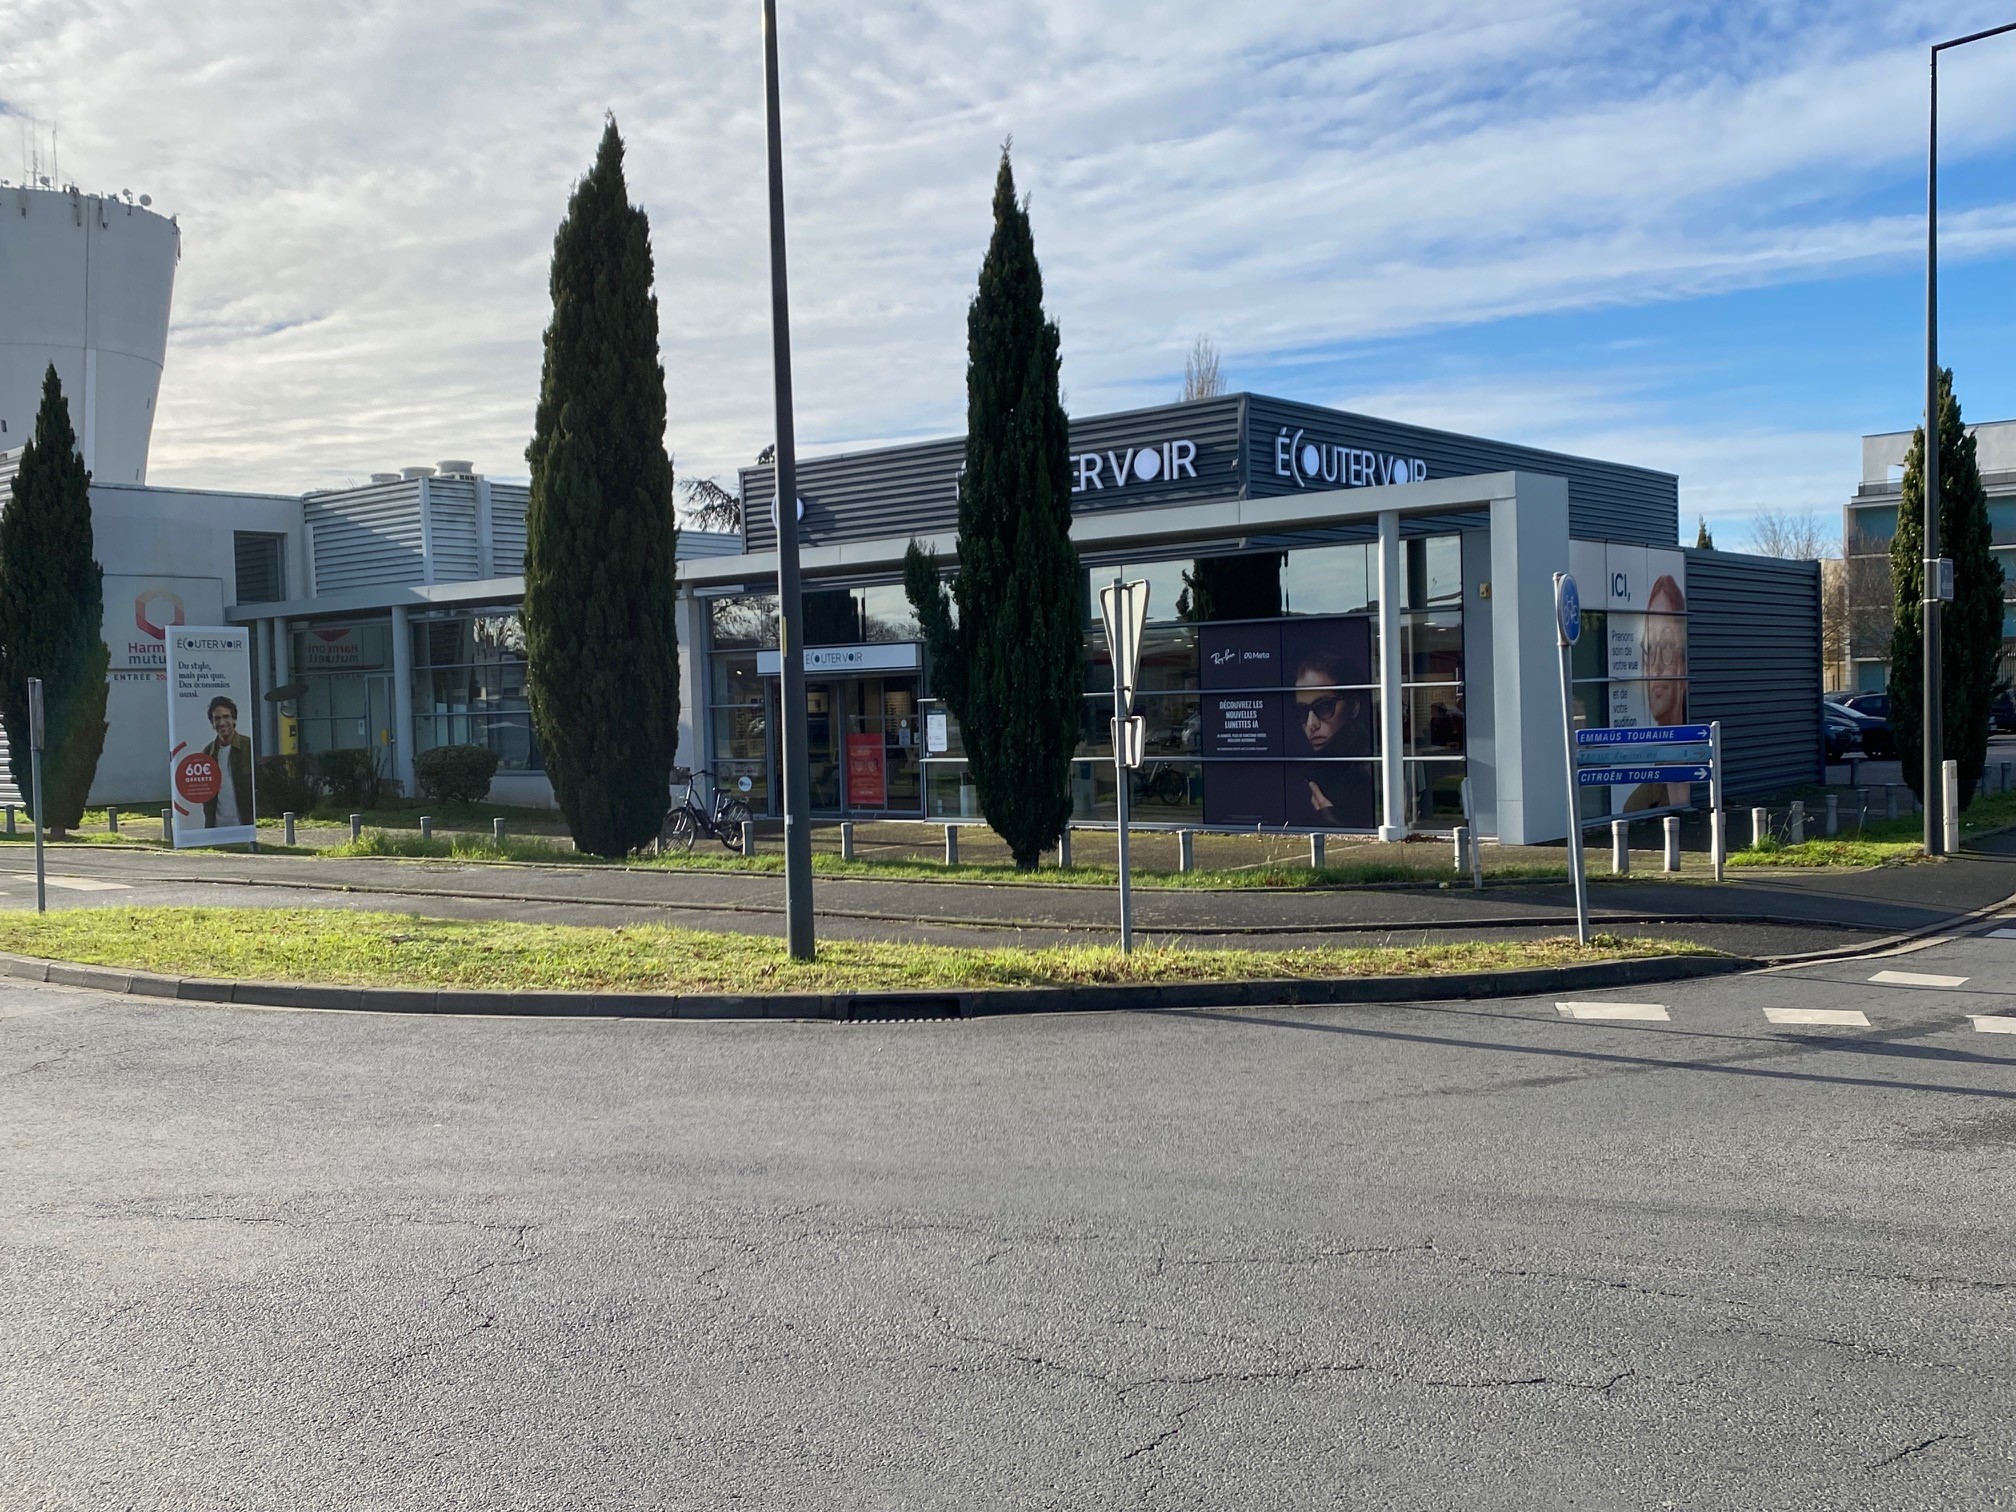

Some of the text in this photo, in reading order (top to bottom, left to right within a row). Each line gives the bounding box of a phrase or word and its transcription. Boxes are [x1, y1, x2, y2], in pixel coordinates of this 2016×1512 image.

[1107, 438, 1199, 487] VOIR
[1378, 453, 1427, 486] VOIR
[1611, 572, 1631, 602] ICI,
[128, 642, 165, 653] Harm
[220, 639, 243, 649] VOIR
[1624, 645, 1633, 656] de
[128, 654, 166, 664] mutu
[842, 651, 863, 663] VOIR
[178, 661, 190, 670] Du
[1628, 660, 1639, 671] vue
[113, 672, 151, 681] ENTRÉE
[1620, 688, 1629, 700] de
[1219, 699, 1264, 710] DÉCOUVREZ LES
[1225, 710, 1258, 719] NOUVELLES
[1224, 720, 1252, 729] LUNETTES
[1580, 730, 1675, 743] EMMAÜS TOURAINE
[186, 763, 211, 776] 60€
[1580, 770, 1660, 782] CITROËN TOURS
